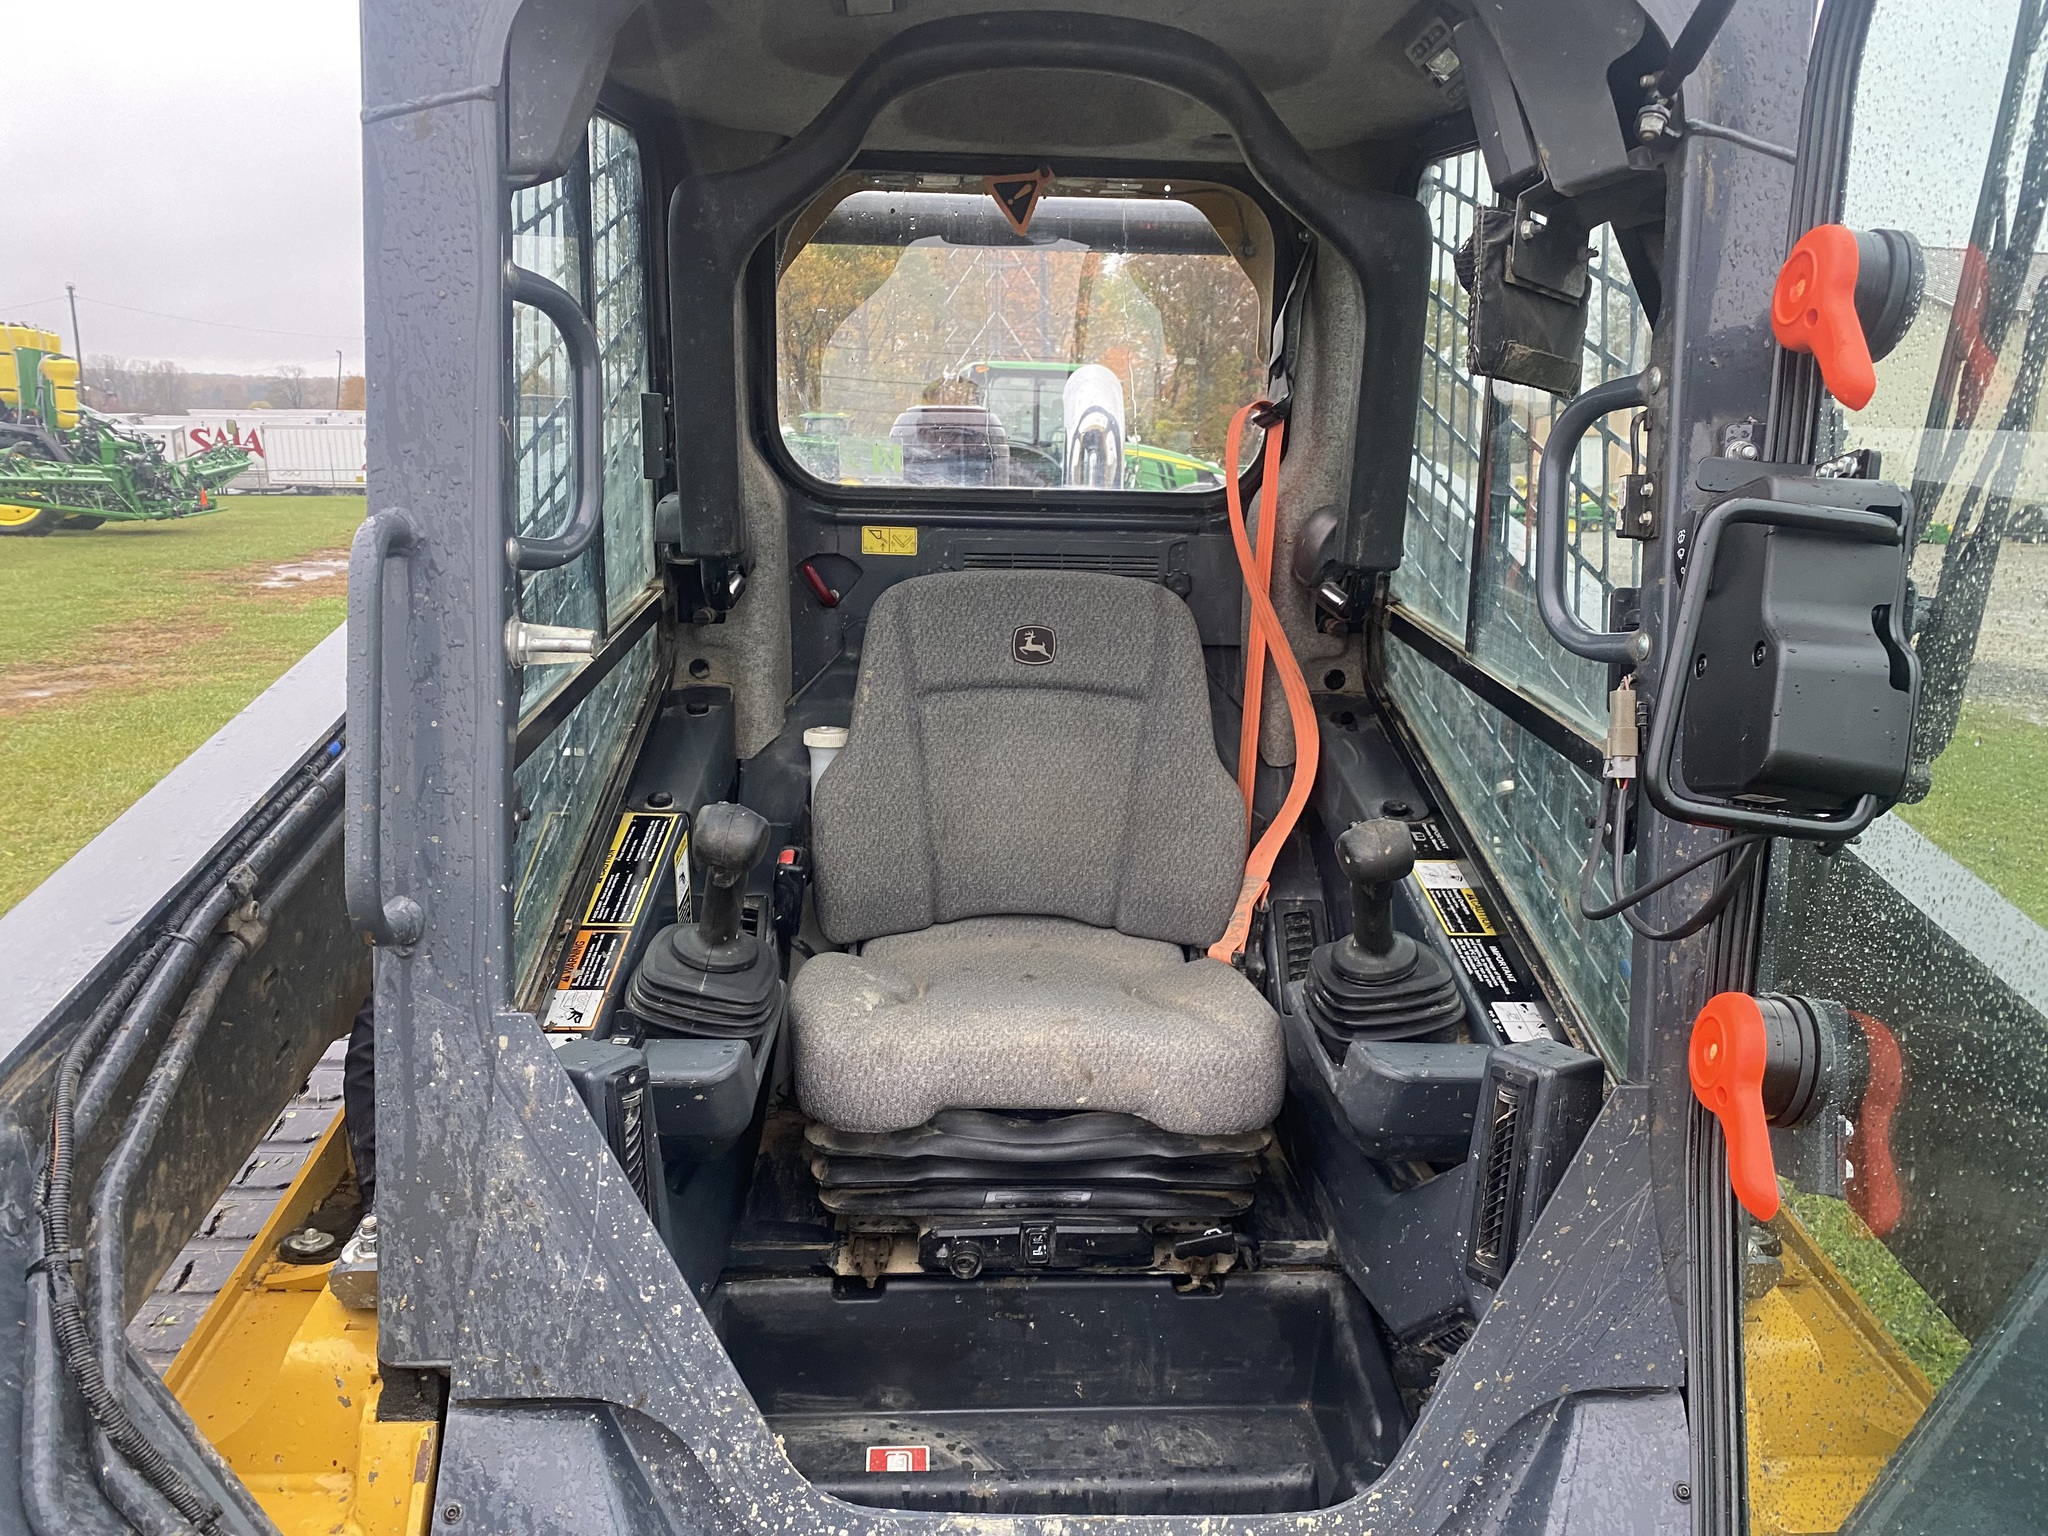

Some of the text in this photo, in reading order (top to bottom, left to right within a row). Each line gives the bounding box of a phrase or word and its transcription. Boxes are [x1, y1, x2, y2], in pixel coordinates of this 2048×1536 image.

[1471, 899, 1493, 930] CAUTION
[564, 940, 585, 976] WARNING
[1489, 945, 1517, 983] IMPORTANT
